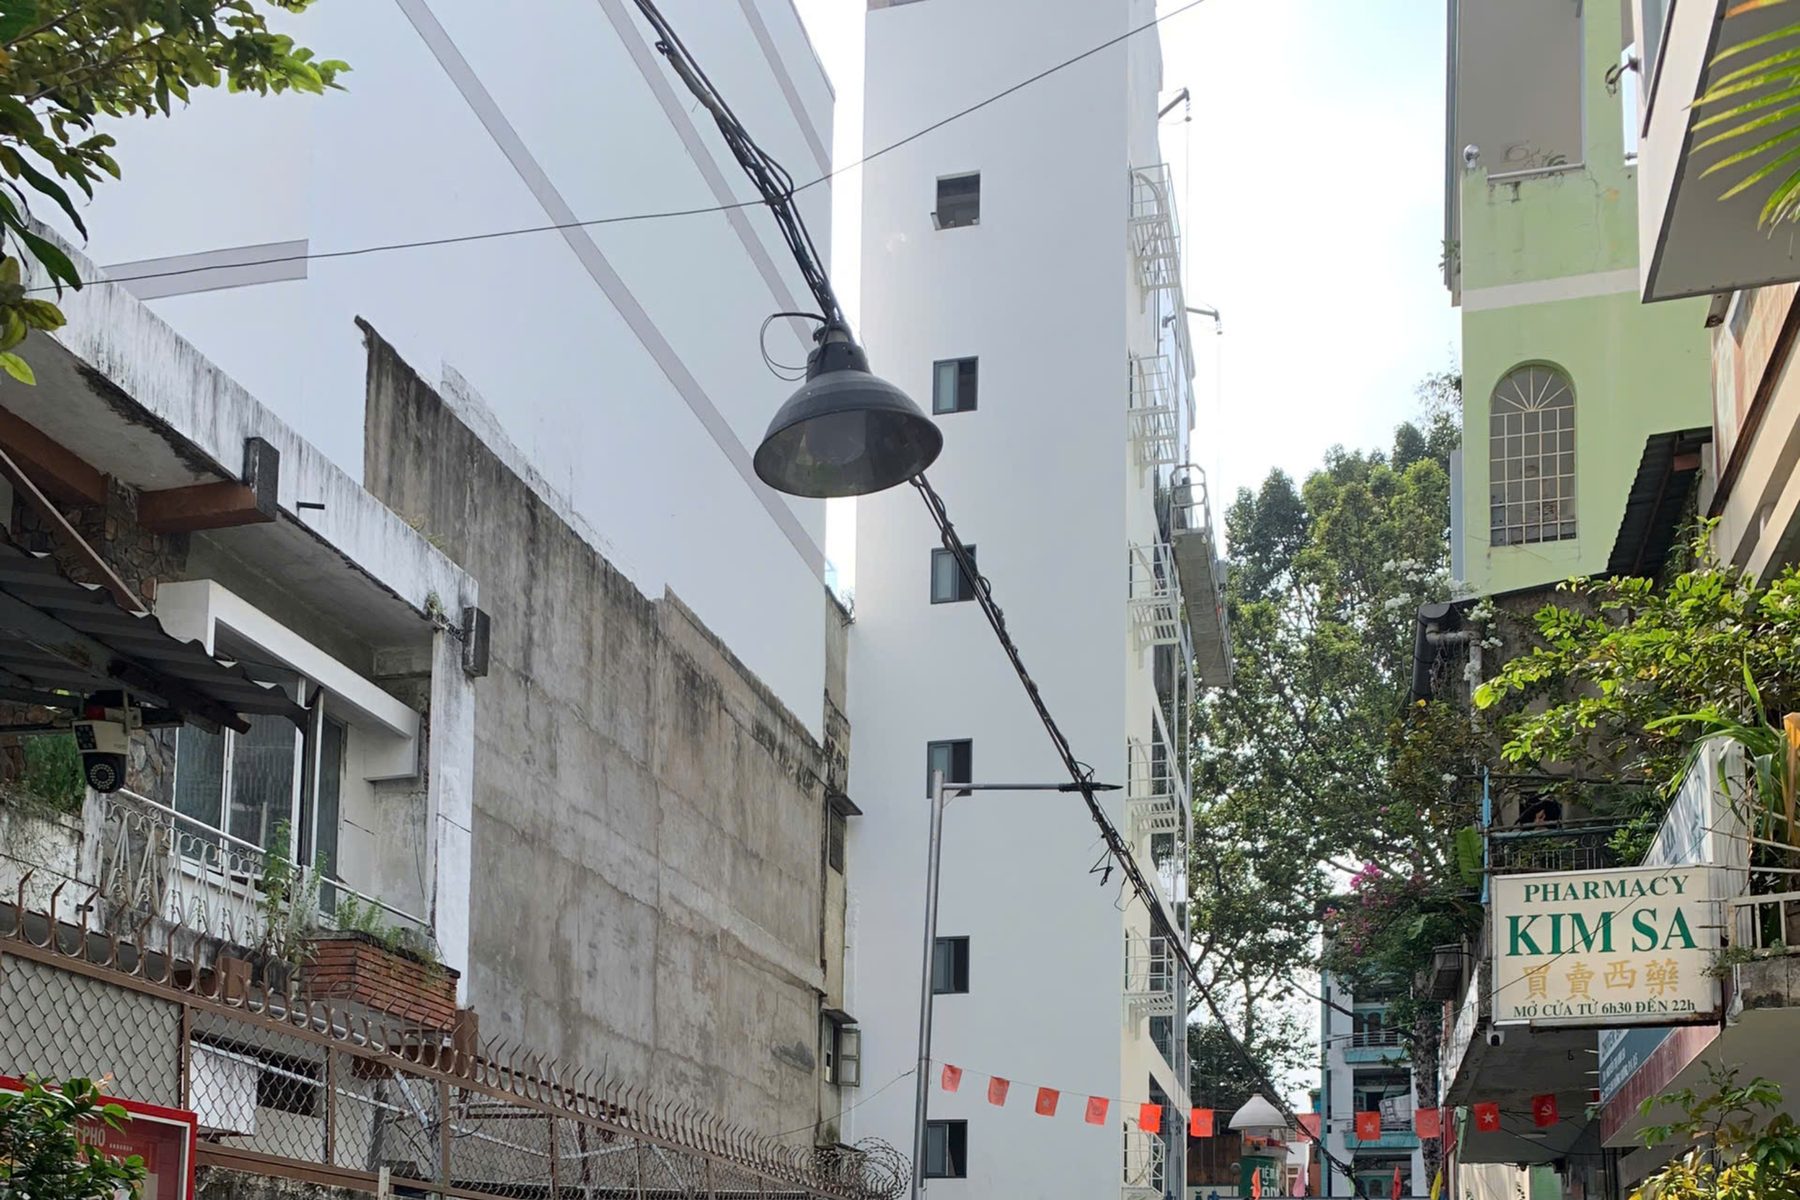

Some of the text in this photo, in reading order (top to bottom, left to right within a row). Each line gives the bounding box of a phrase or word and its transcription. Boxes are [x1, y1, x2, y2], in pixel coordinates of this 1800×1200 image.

[1523, 875, 1689, 903] PHARMACY
[1505, 906, 1699, 956] KIM SA
[1513, 995, 1696, 1017] MỞ CỬA TỪ 6h30 ĐẾN 22h
